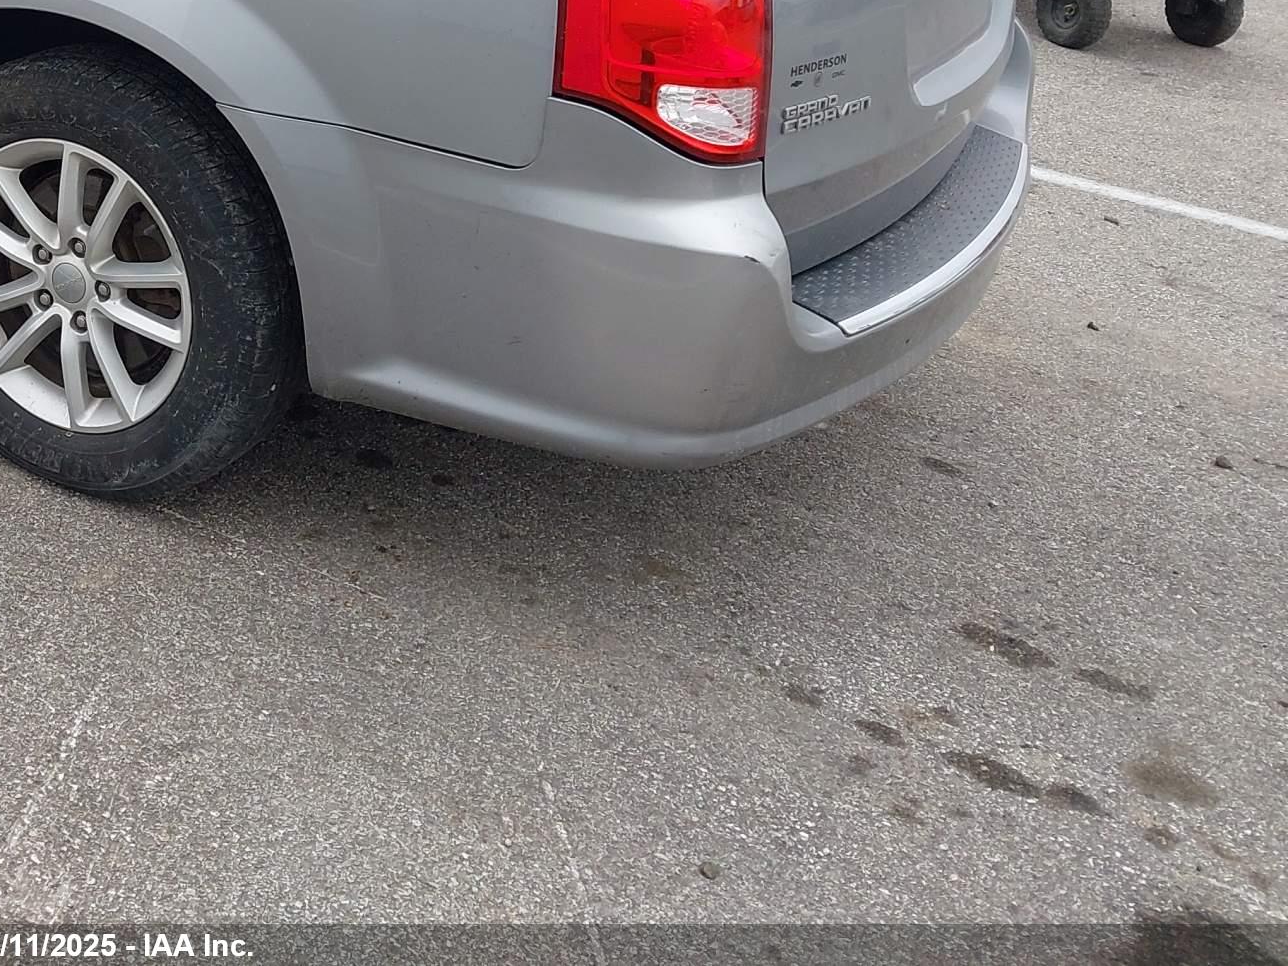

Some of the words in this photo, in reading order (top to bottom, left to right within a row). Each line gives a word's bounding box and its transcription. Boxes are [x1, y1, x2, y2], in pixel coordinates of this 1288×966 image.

[791, 53, 848, 77] HENDERSON
[782, 95, 872, 133] CARAVAN
[783, 94, 839, 120] GRAND
